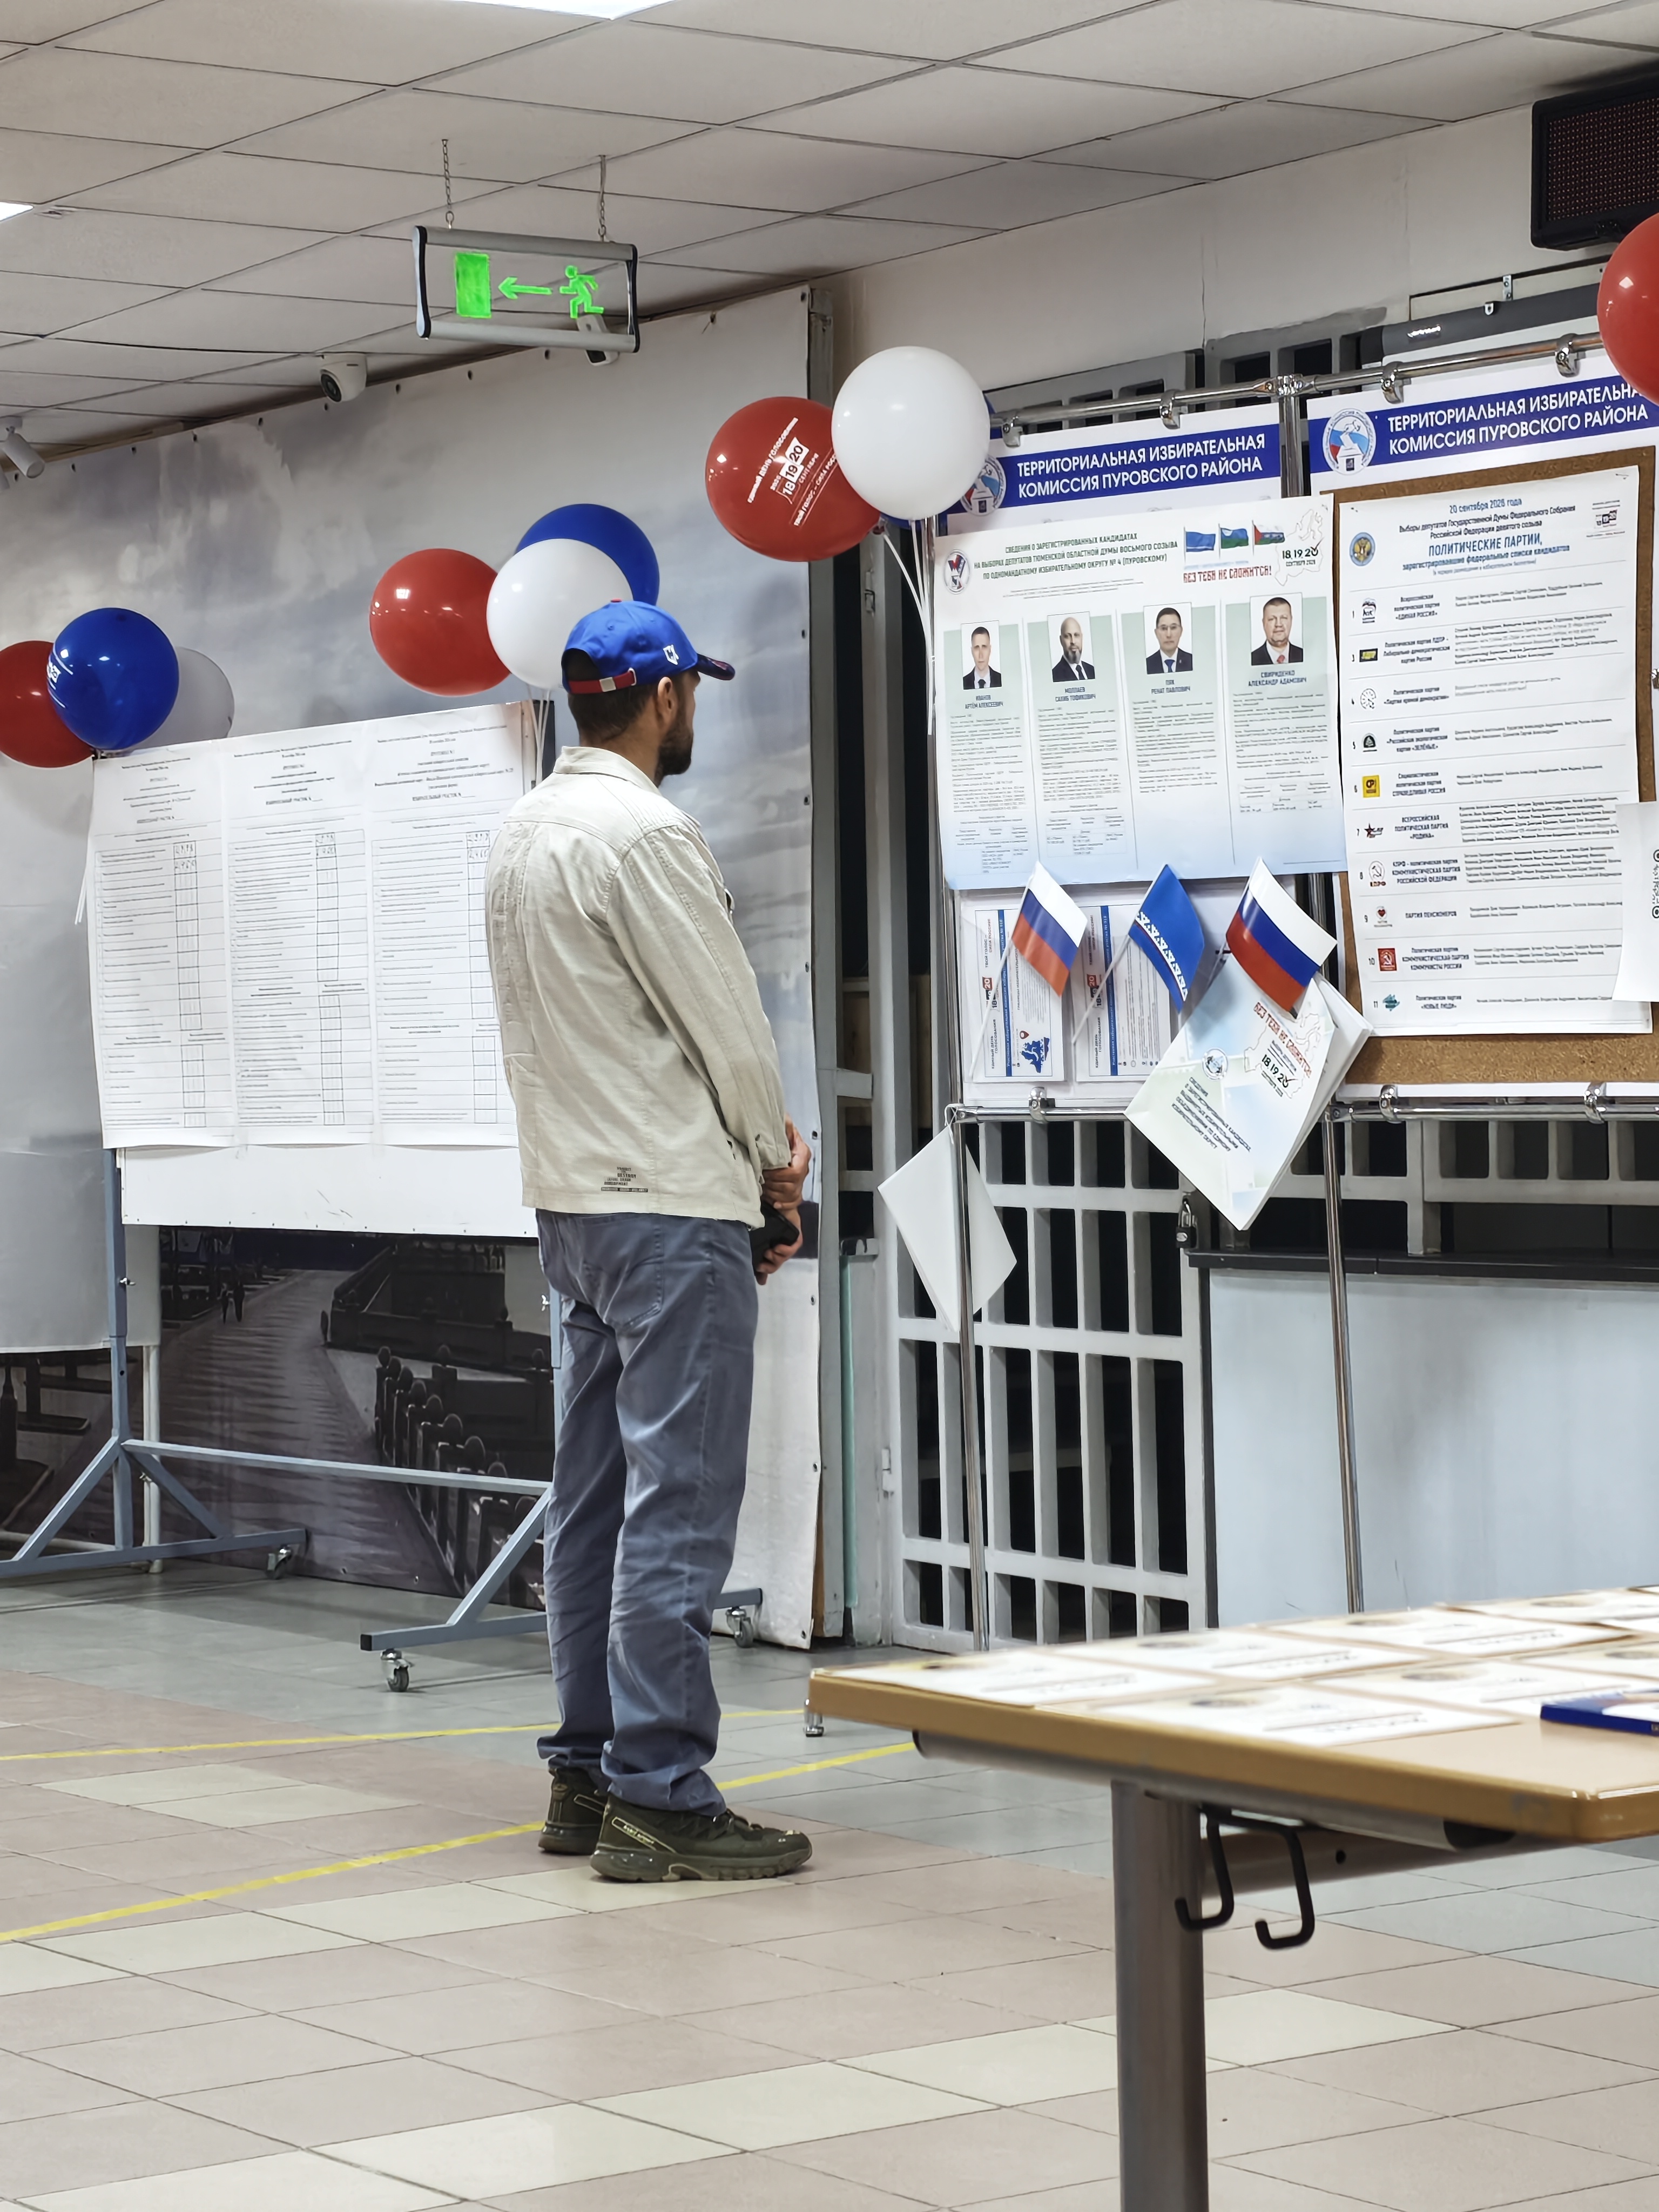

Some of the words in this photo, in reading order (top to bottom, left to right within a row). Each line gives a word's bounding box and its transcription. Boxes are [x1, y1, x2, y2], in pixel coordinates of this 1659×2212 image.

[1387, 397, 1525, 432] ТЕРРИТОРИАЛЬНАЯ
[1529, 381, 1642, 412] ИЗБИРАТЕЛЬН
[1390, 428, 1475, 455] КОМИССИЯ
[1479, 414, 1580, 443] ПУРОВСКОГО
[1584, 403, 1648, 428] РАЙОНА
[789, 445, 803, 462] 20
[1017, 448, 1145, 477] ТЕРРИТОРИАЛЬНАЯ
[1149, 433, 1264, 461] ИЗБИРАТЕЛЬНАЯ
[785, 463, 798, 478] 19
[1019, 475, 1098, 498] КОМИССИЯ
[1102, 463, 1198, 488] ПУРОВСКОГО
[1201, 456, 1262, 477] РАЙОНА
[782, 480, 795, 495] 18
[1449, 504, 1457, 514] 20
[1428, 537, 1501, 556] ПОЛИТИЧЕСКИЕ
[1504, 532, 1542, 548] ПАРТИИ,
[984, 978, 990, 989] 20
[1089, 976, 1095, 986] 20
[1096, 998, 1102, 1007] 18
